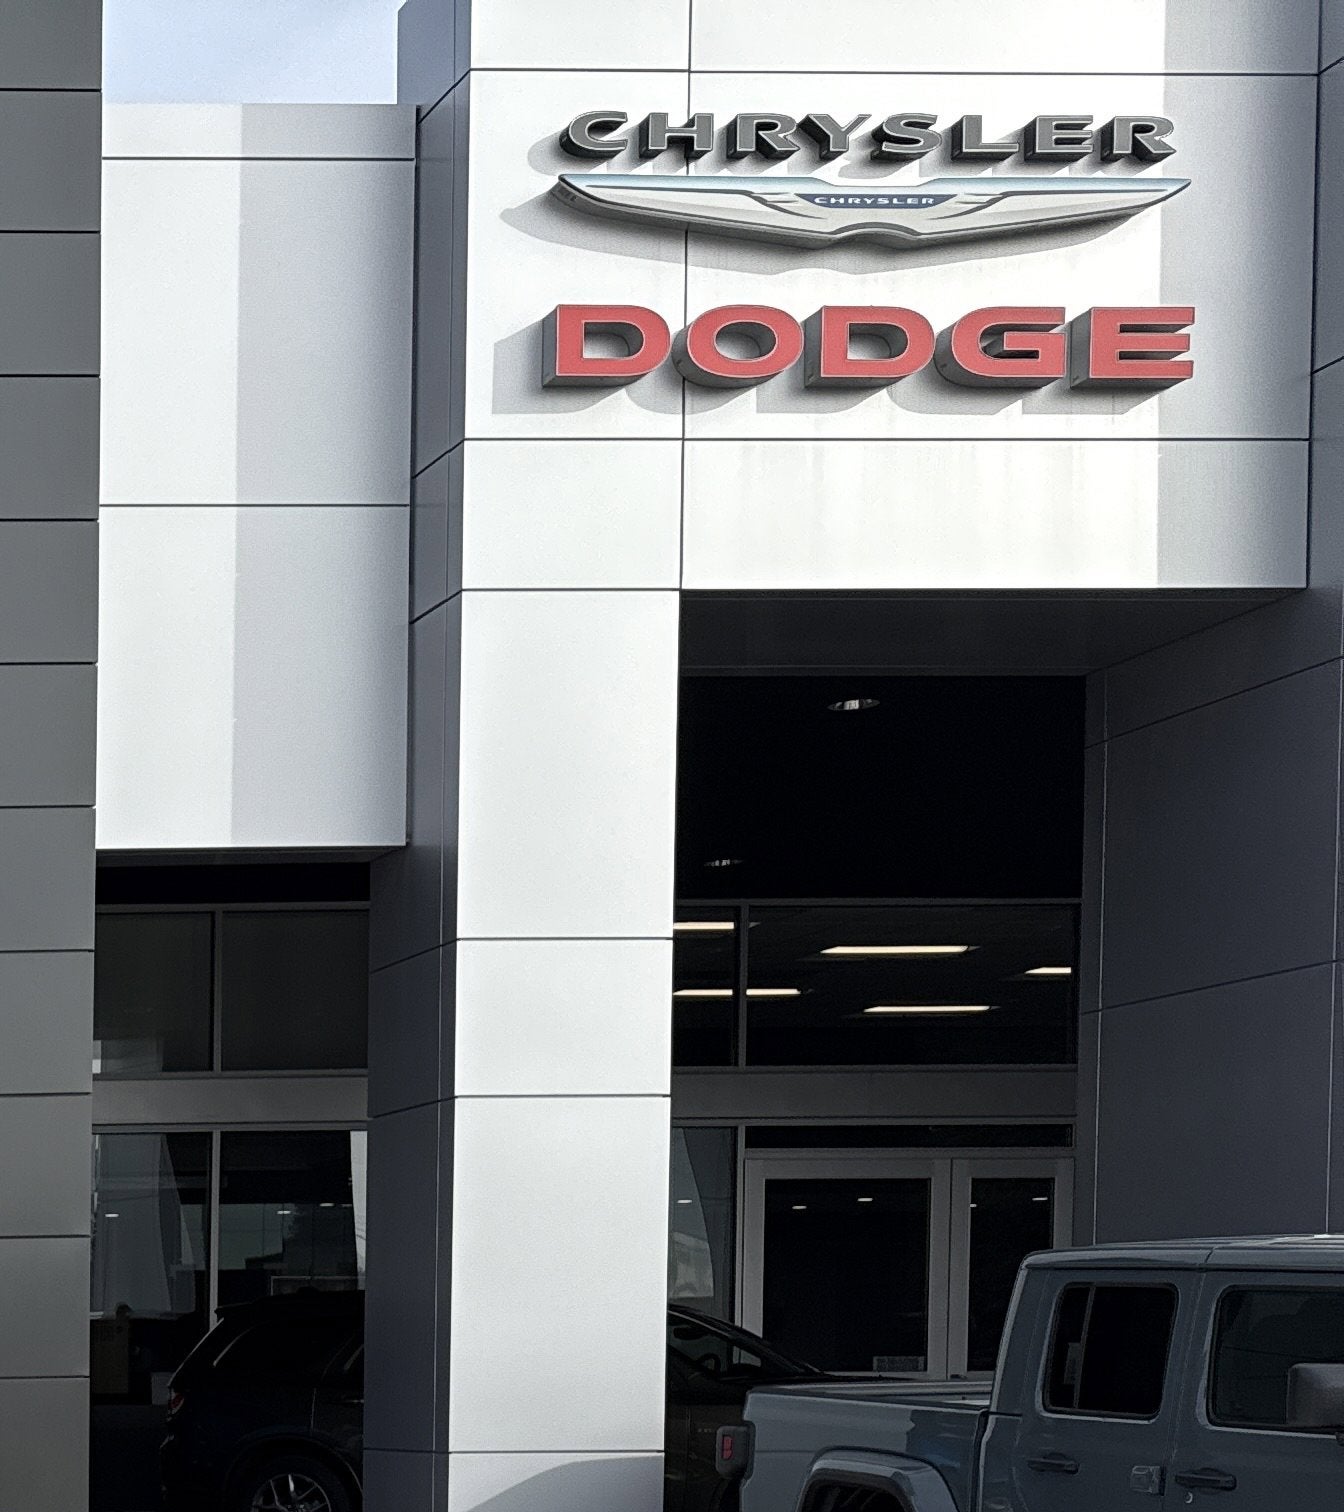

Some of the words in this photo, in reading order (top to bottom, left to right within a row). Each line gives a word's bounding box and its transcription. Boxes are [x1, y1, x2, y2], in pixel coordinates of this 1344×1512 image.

[562, 110, 1177, 160] CHRYSLER
[814, 196, 935, 205] CHRYSLER
[546, 304, 1196, 387] DODGE
